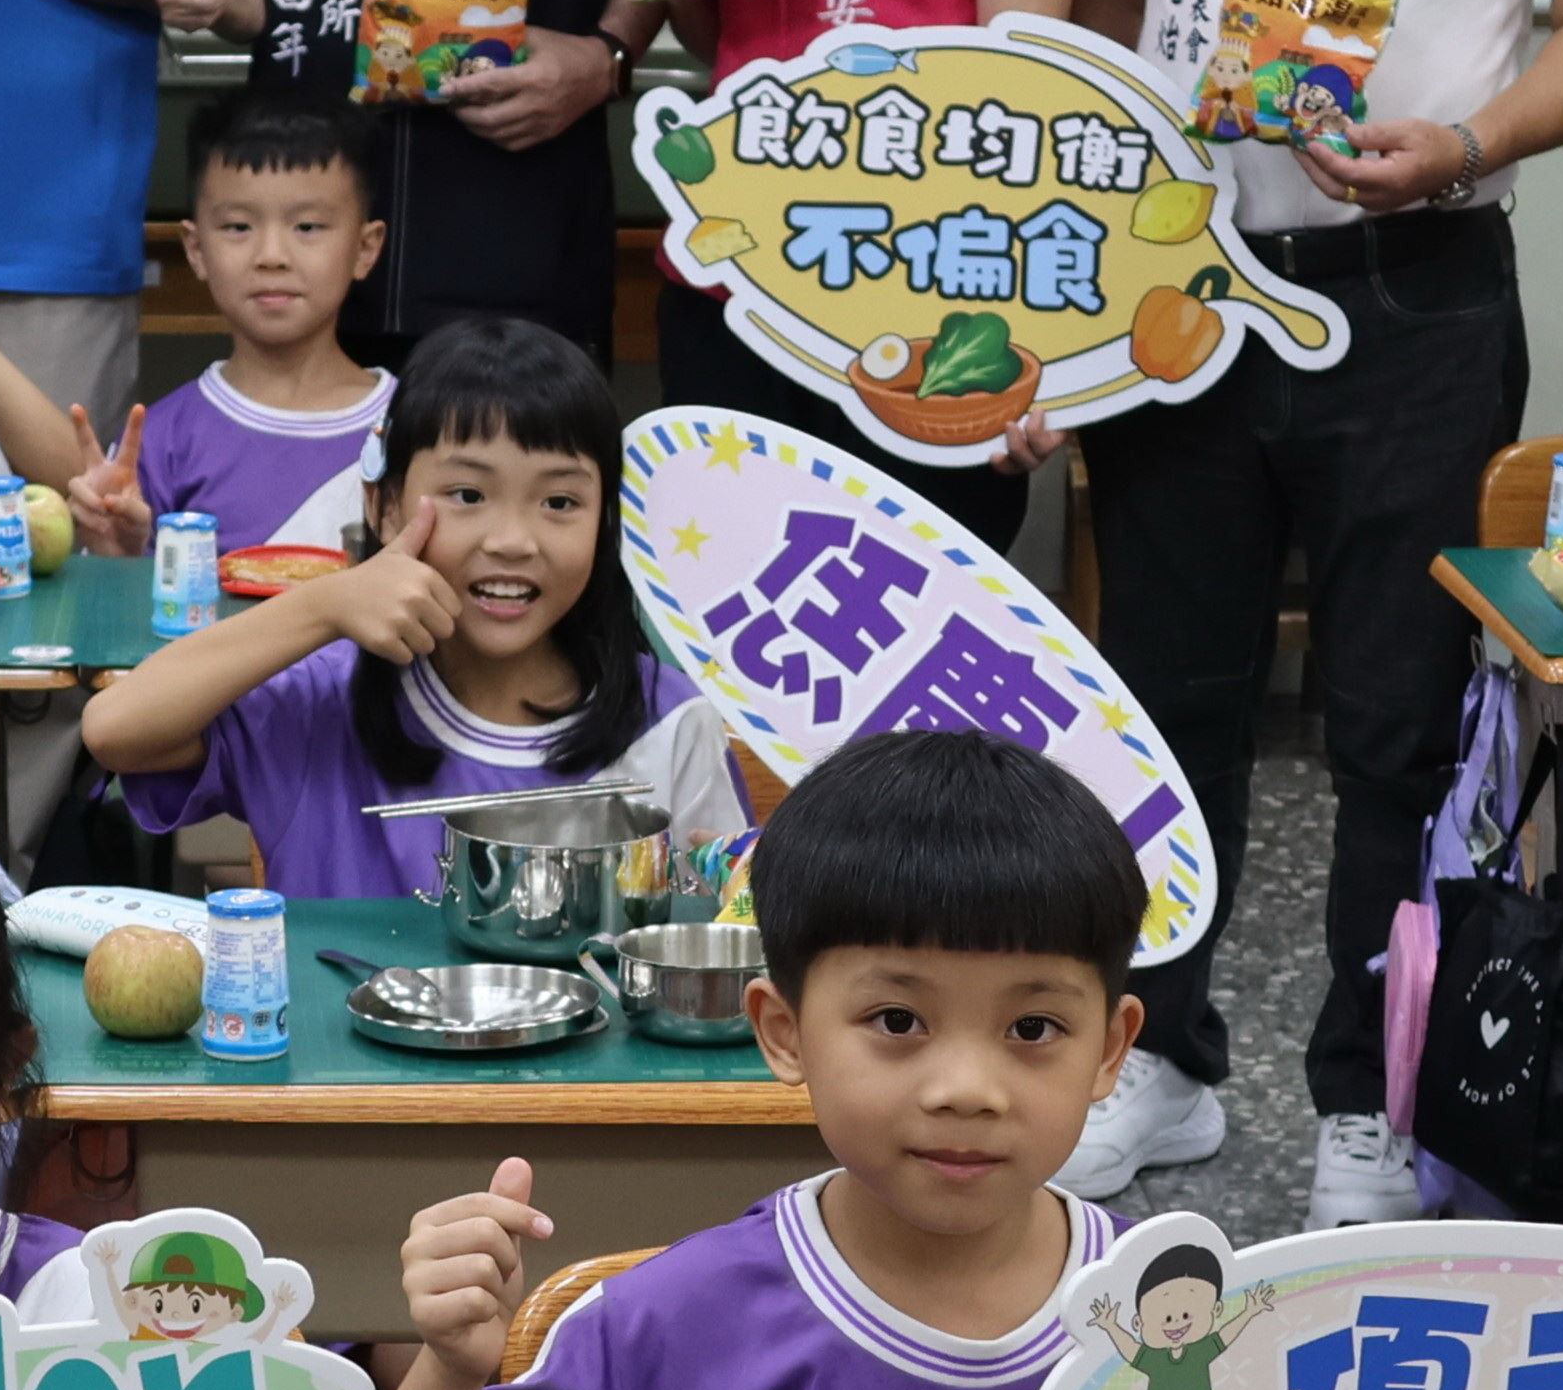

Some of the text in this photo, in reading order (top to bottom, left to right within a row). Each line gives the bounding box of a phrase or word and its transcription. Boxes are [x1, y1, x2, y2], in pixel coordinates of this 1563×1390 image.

[732, 74, 1153, 193] 飲食均衡
[782, 200, 1110, 316] 不偏食
